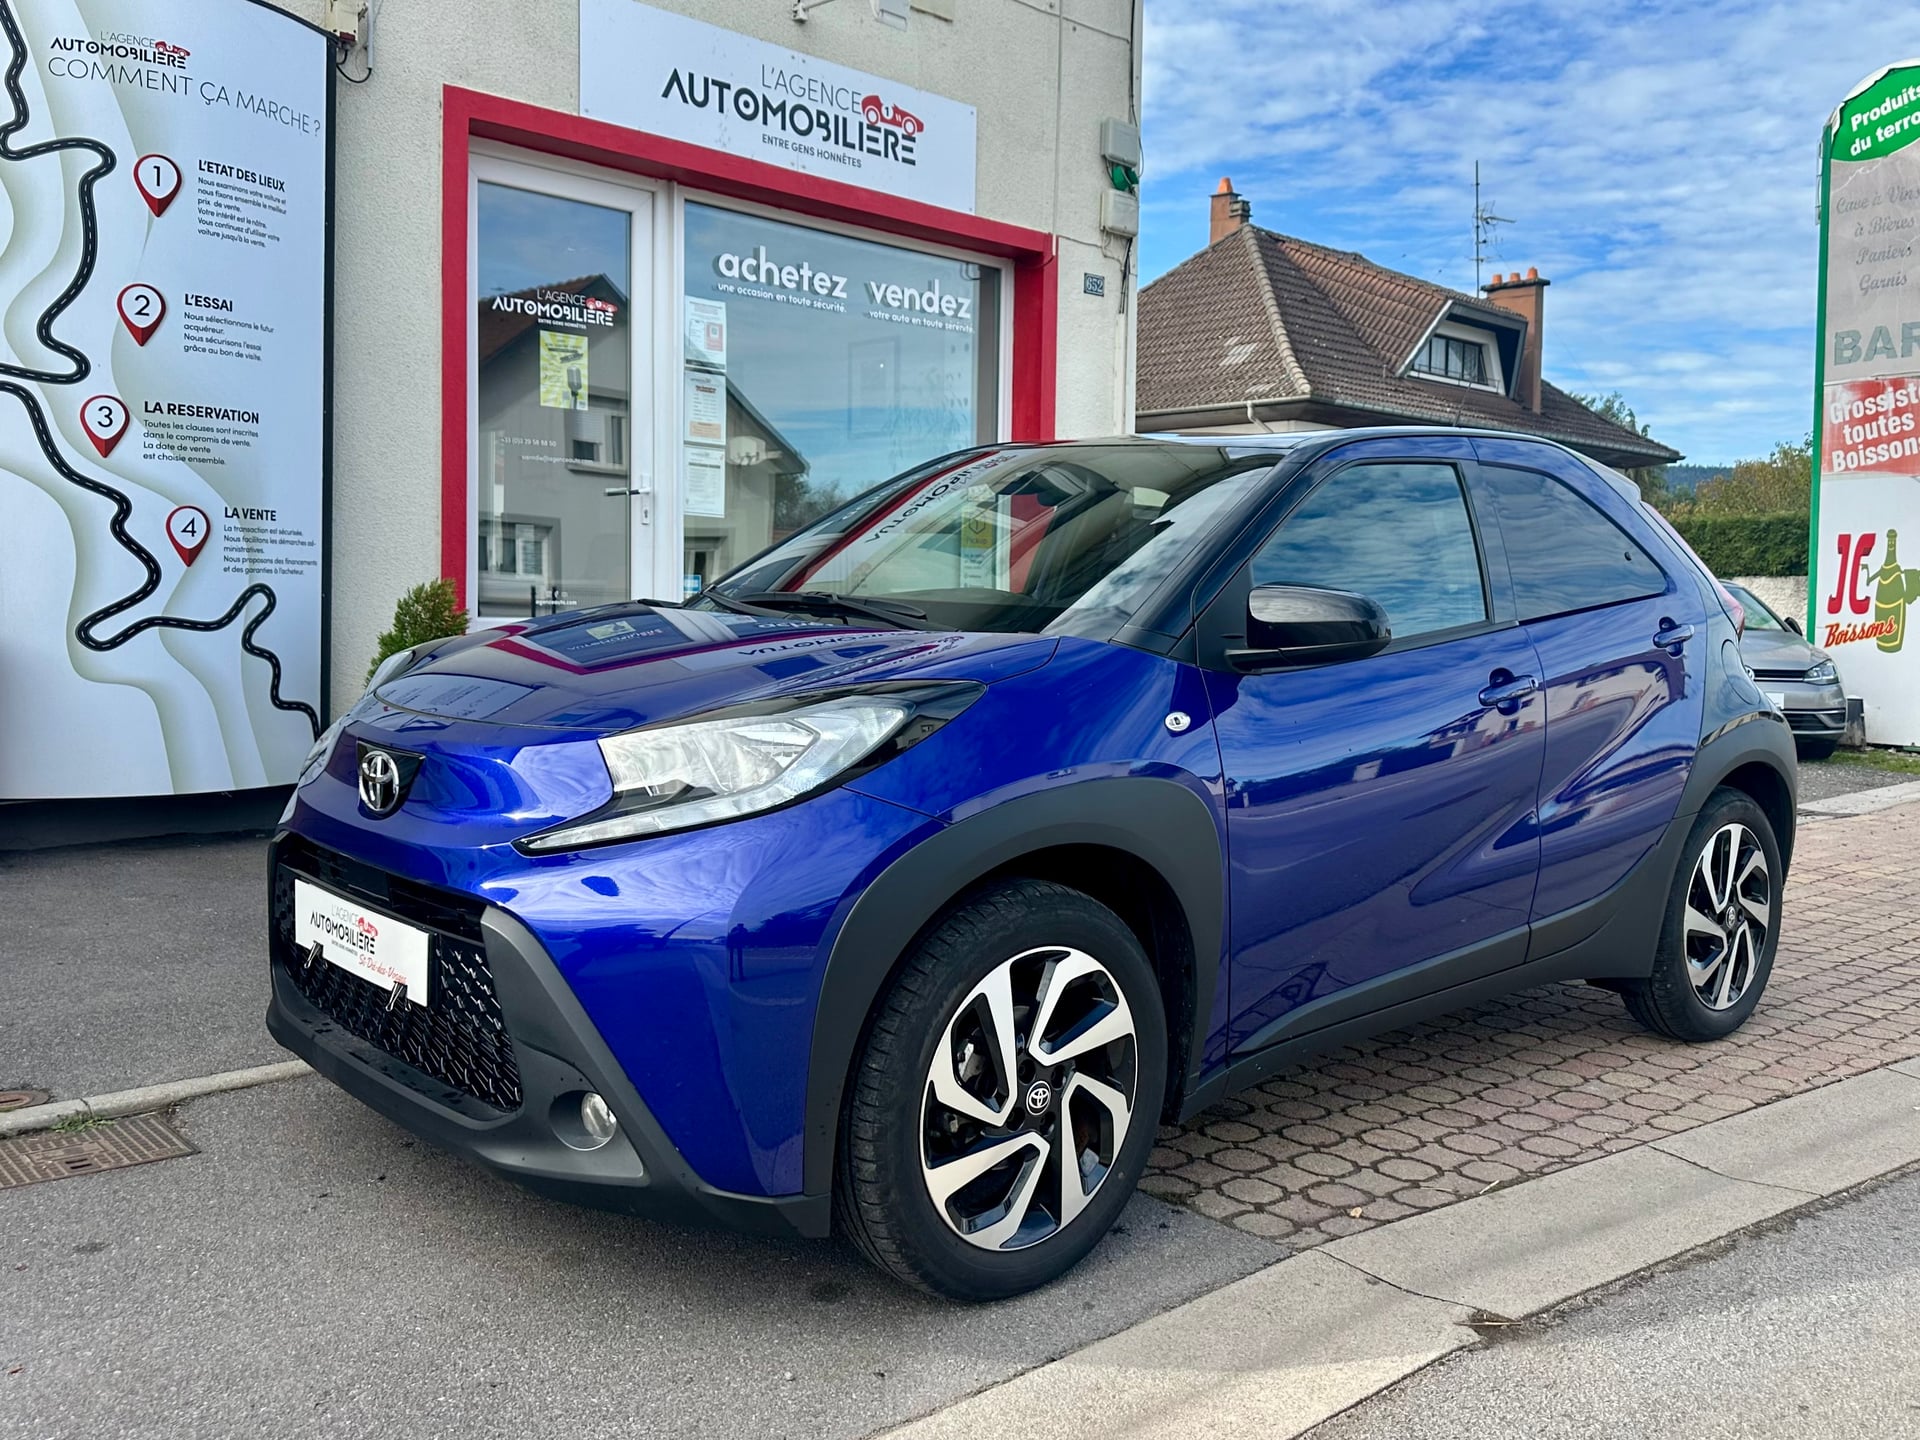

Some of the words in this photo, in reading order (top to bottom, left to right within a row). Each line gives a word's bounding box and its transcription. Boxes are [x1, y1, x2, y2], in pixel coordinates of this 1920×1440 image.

[101, 31, 155, 48] L'AGENCE
[48, 57, 193, 95] COMMENT
[200, 81, 230, 106] ÇA
[237, 90, 309, 134] MARCHE
[762, 64, 862, 114] L'AGENCE
[762, 134, 790, 150] ENTRE
[791, 142, 815, 156] GENS
[816, 147, 862, 168] HONNÊTES
[1850, 135, 1871, 156] du
[153, 166, 161, 187] 1
[198, 159, 234, 177] L'ETAT
[236, 168, 256, 183] DES
[259, 174, 285, 192] LIEUX
[198, 177, 215, 186] Nous
[215, 190, 233, 200] fixons
[198, 207, 215, 216] Votre
[198, 217, 213, 226] Vous
[215, 221, 243, 232] continuez
[198, 228, 220, 237] voiture
[718, 246, 848, 298] achetez
[1086, 277, 1103, 293] 652
[134, 294, 150, 316] 2
[185, 294, 233, 312] L'ESSAI
[537, 289, 586, 306] L'AGENCE
[718, 282, 735, 293] une
[737, 286, 773, 300] occasion
[776, 293, 787, 302] en
[789, 294, 811, 306] toute
[813, 297, 847, 313] sécurité.
[870, 279, 971, 319] vendez
[184, 312, 204, 321] Nous
[205, 314, 252, 329] sélectionnons
[253, 322, 259, 330] le
[184, 323, 224, 335] acquéreur.
[870, 311, 890, 321] votre
[892, 314, 909, 324] auto
[912, 317, 921, 325] en
[923, 318, 943, 329] toute
[184, 333, 203, 342] Nous
[205, 334, 242, 347] sécurisons
[184, 344, 206, 353] grâce
[220, 346, 233, 357] bon
[235, 349, 244, 358] de
[144, 401, 164, 414] LA
[167, 402, 259, 424] RESERVATION
[1830, 383, 1920, 424] Grossist
[97, 406, 113, 428] 3
[144, 420, 171, 429] Toutes
[173, 422, 183, 430] les
[186, 423, 214, 433] clauses
[216, 426, 231, 435] sont
[232, 427, 259, 437] inscrites
[1843, 412, 1915, 446] toutes
[143, 431, 164, 439] dans
[167, 431, 173, 440] le
[176, 434, 219, 445] compromis
[220, 436, 230, 445] de
[156, 442, 175, 451] date
[158, 453, 186, 462] choisie
[1832, 437, 1920, 472] Boisson
[224, 507, 240, 519] LA
[242, 508, 277, 521] VENTE
[181, 517, 196, 537] 4
[234, 525, 268, 534] transaction
[242, 536, 268, 545] facilitons
[242, 557, 273, 565] proposons
[1824, 615, 1897, 648] Boissons
